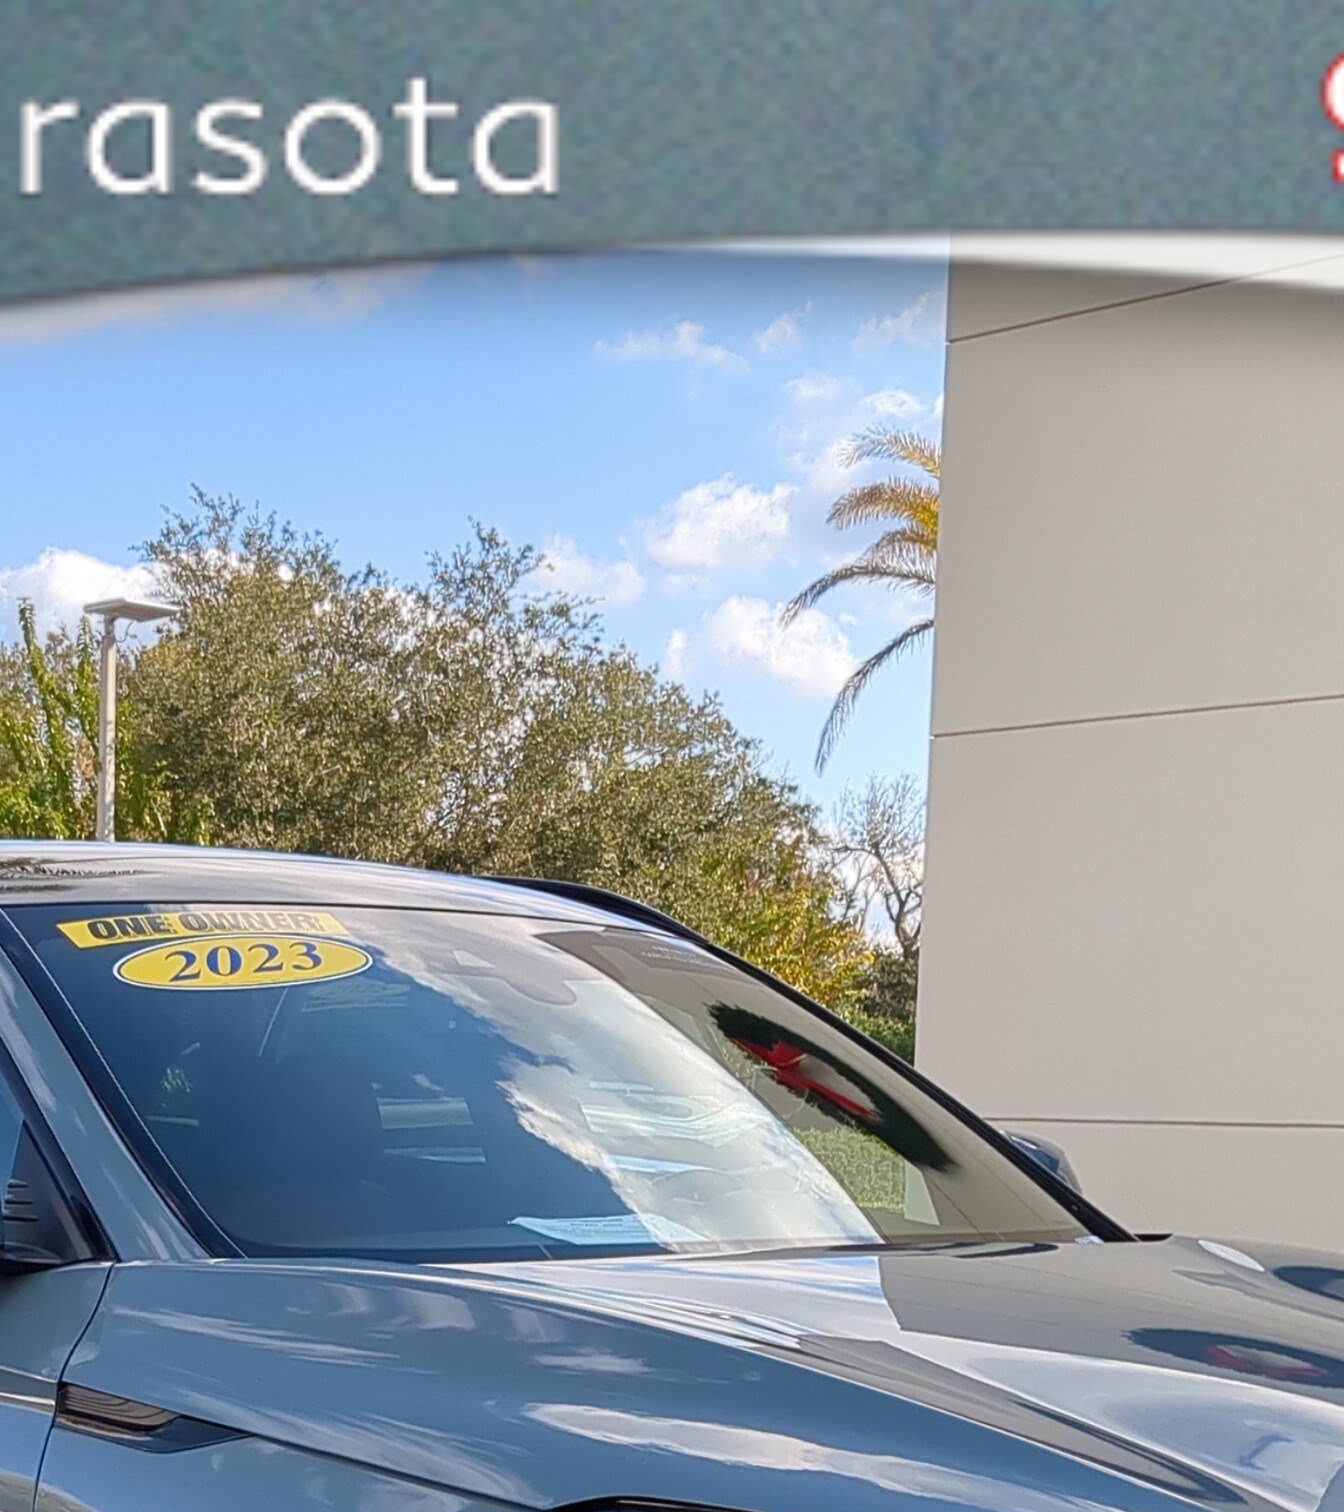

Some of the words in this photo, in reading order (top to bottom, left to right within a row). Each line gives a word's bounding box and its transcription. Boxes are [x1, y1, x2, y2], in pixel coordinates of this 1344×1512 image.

[87, 913, 177, 940] ONE
[178, 911, 324, 932] OWNER
[164, 941, 323, 983] 2023
